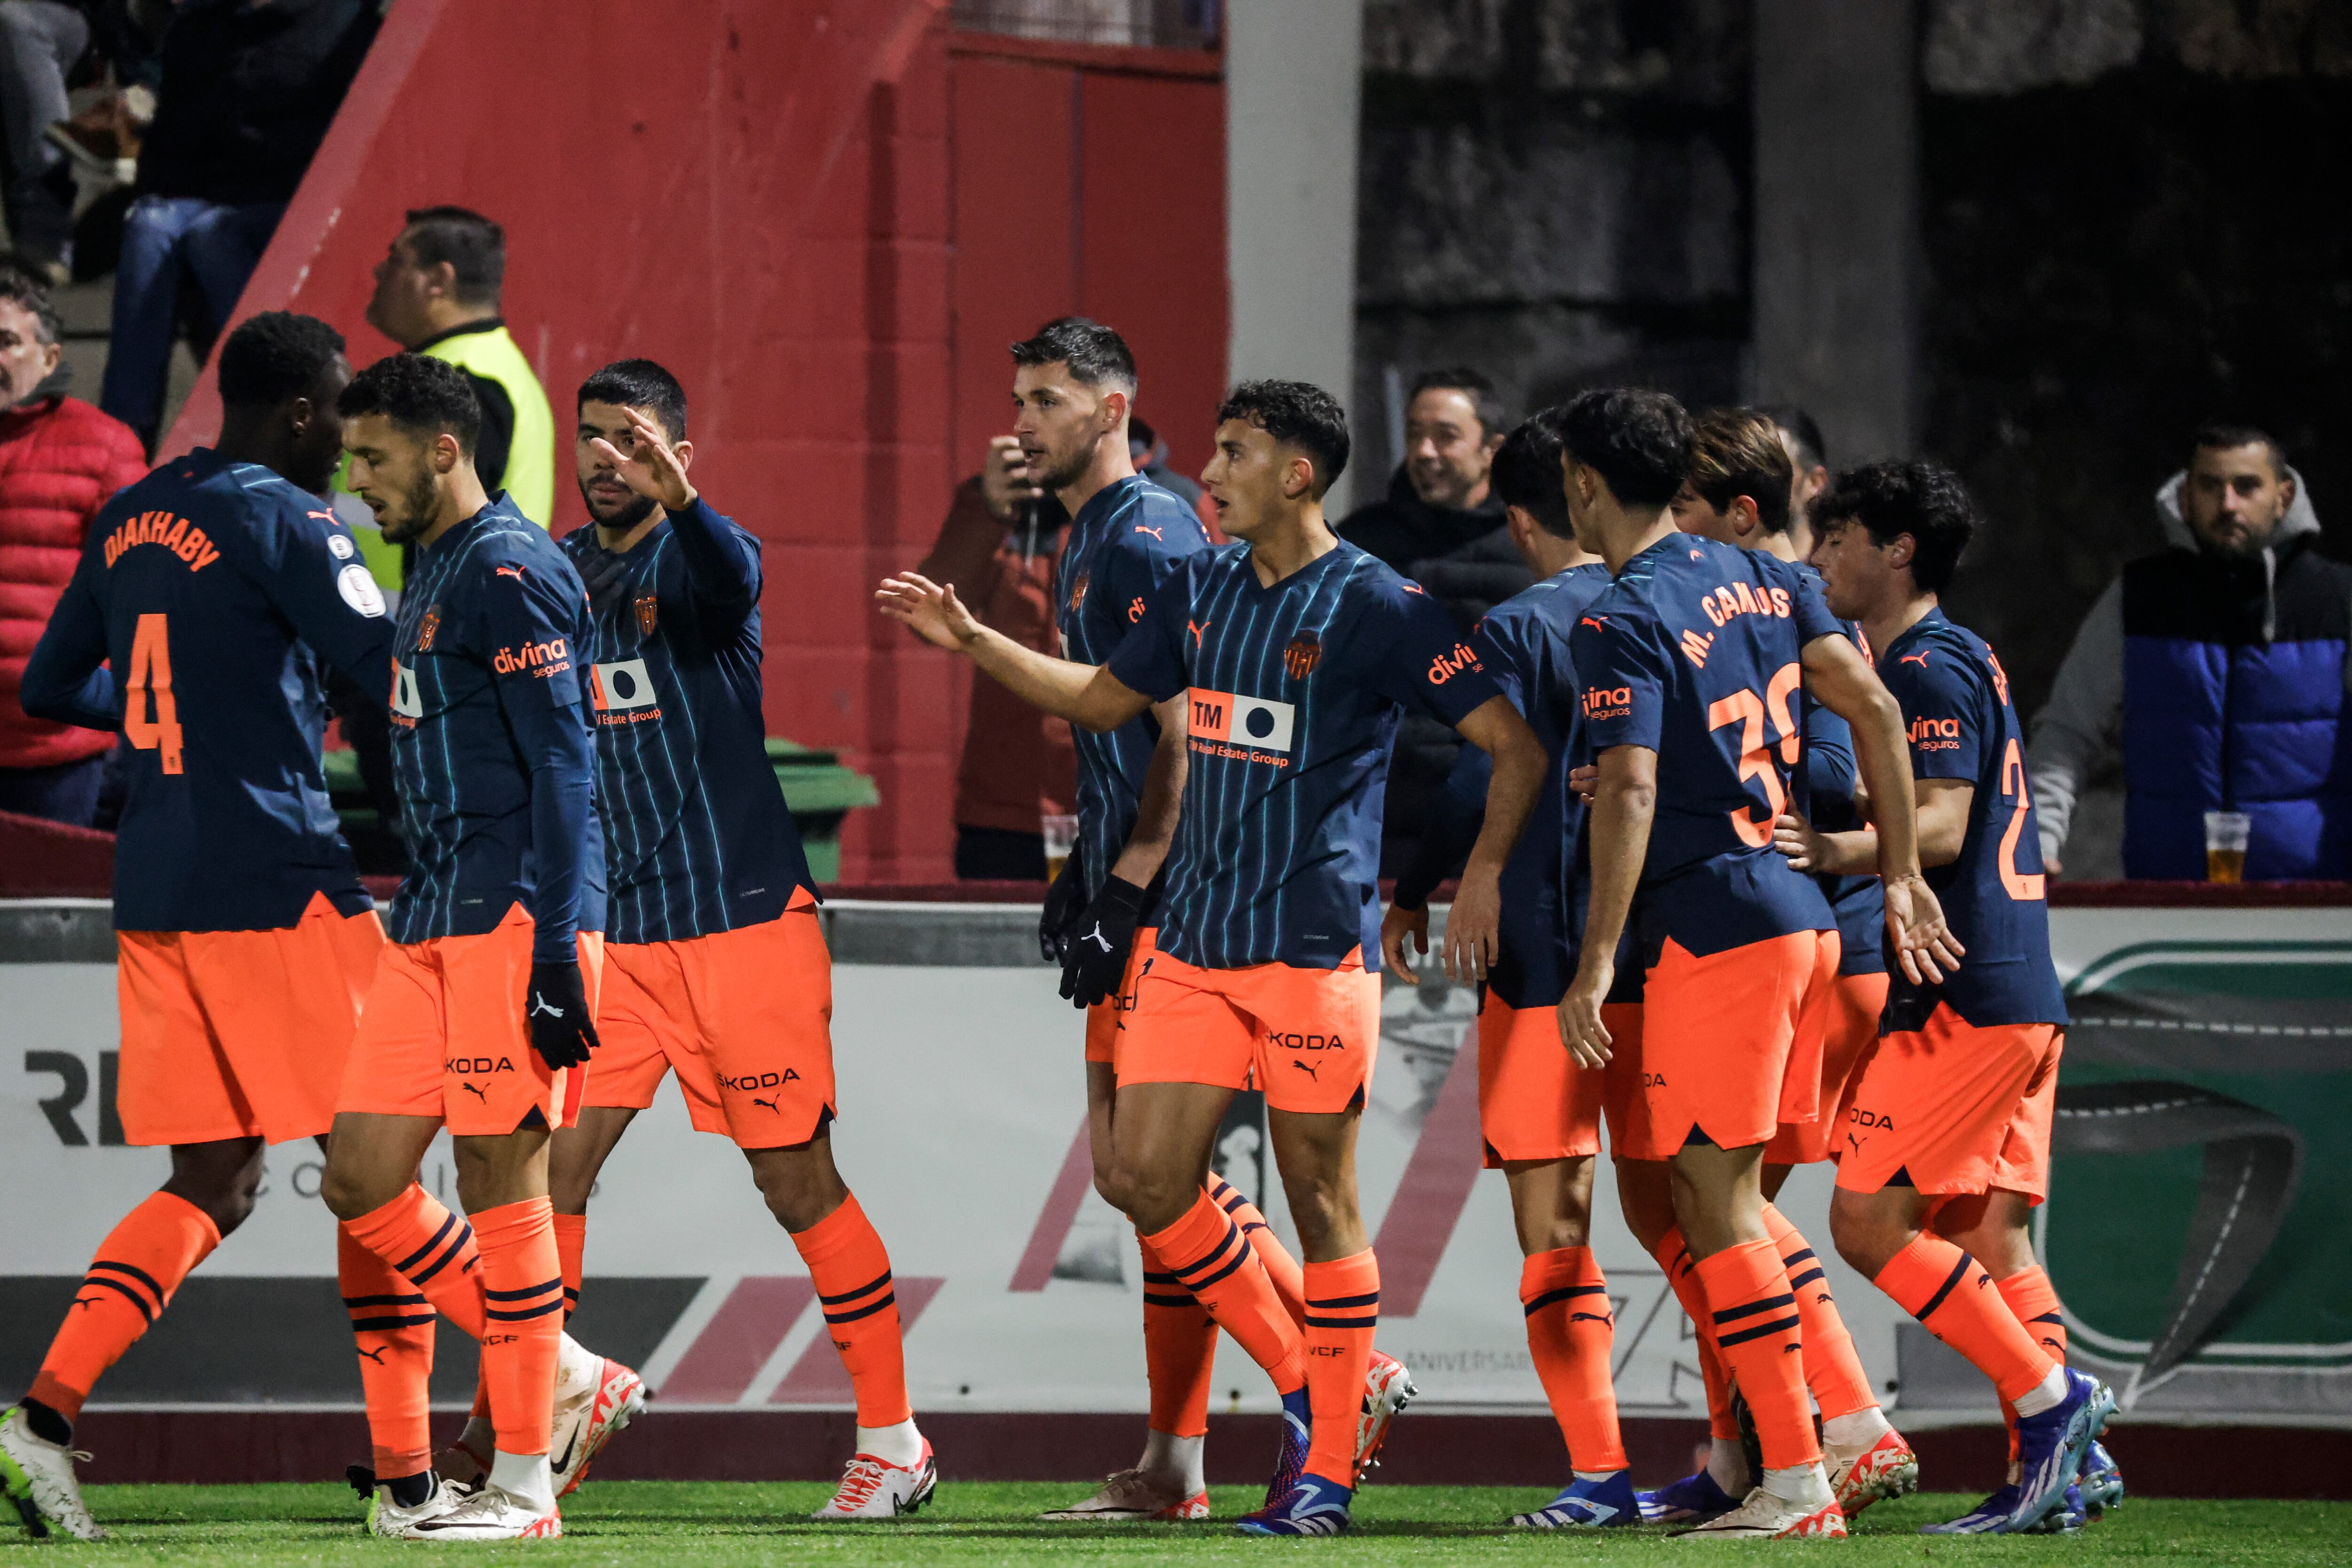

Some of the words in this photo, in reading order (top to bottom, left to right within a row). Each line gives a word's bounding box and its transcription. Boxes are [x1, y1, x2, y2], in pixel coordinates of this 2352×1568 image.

[104, 510, 220, 572] DIAKHABY
[494, 638, 567, 674] divina
[1681, 629, 1715, 669] M.
[533, 661, 571, 678] seguros
[124, 613, 184, 774] 4
[603, 714, 627, 725] Estate
[628, 708, 662, 723] Group
[1194, 701, 1222, 729] TM
[1198, 741, 1216, 755] Real
[1217, 746, 1248, 761] Estate
[1250, 751, 1289, 769] Group
[1918, 740, 1960, 752] seguros
